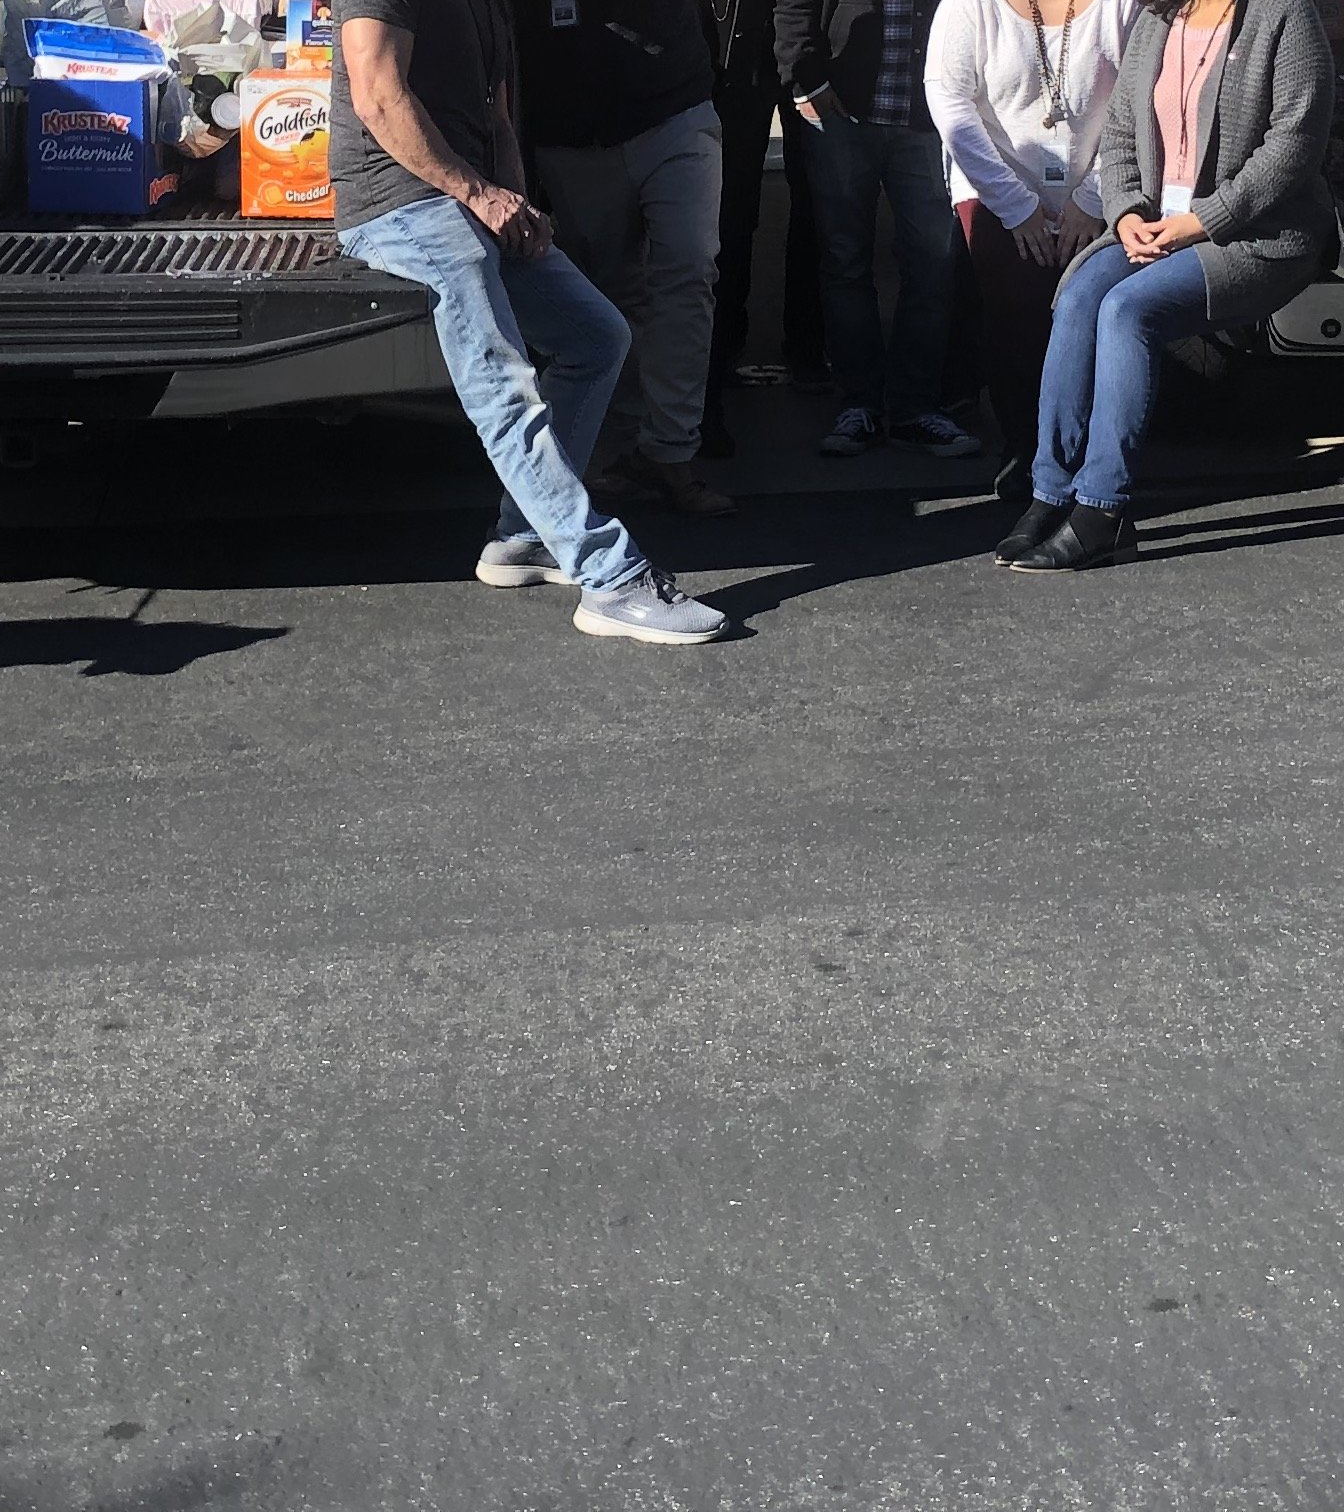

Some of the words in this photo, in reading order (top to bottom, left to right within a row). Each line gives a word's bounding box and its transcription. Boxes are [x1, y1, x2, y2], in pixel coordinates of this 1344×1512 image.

[67, 62, 119, 76] KRUSTEAZ
[42, 109, 132, 135] KRUSTEAZ
[260, 107, 326, 139] Goldfish
[38, 139, 133, 161] Buttermilk
[285, 182, 331, 202] Cheddar
